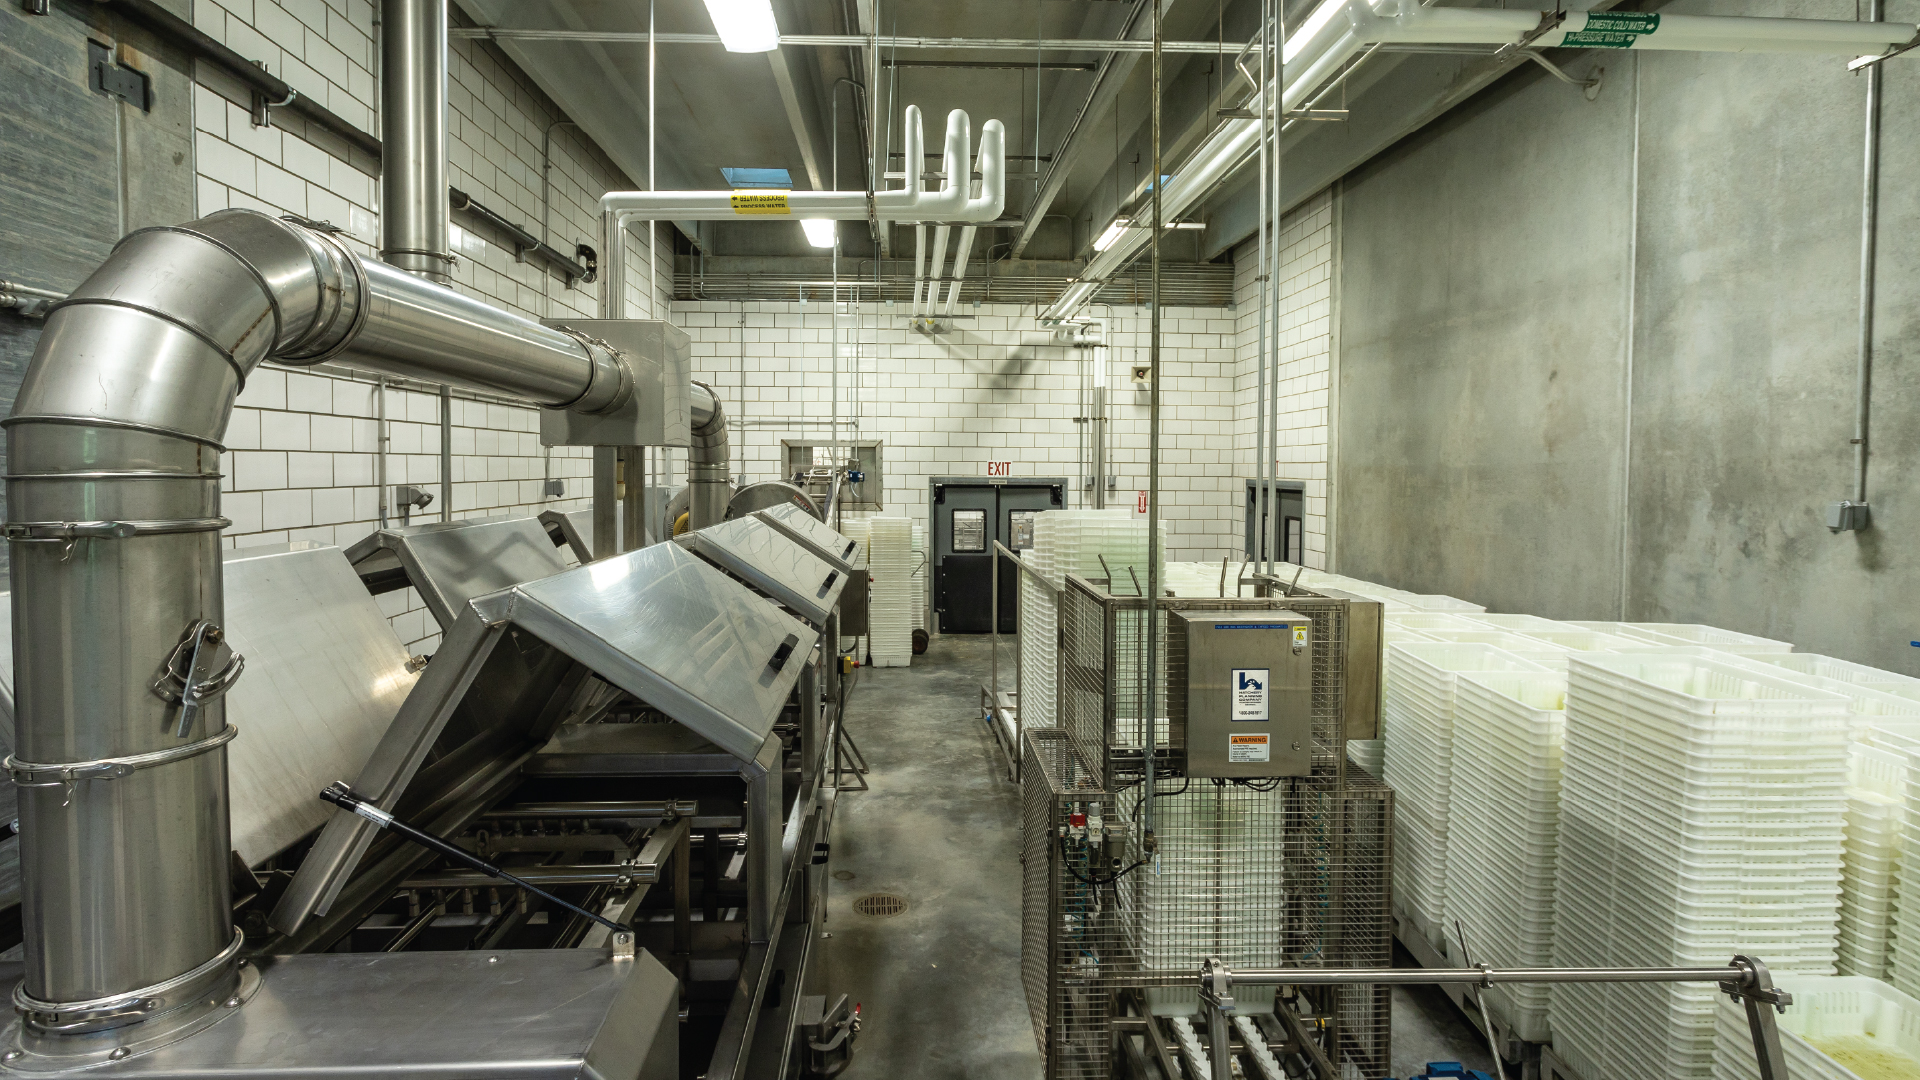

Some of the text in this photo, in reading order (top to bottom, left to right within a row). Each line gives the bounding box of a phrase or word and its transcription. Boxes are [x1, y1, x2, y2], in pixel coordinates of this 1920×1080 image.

[1587, 20, 1646, 30] DOMESTIC COLD WATER
[1604, 34, 1624, 42] WATER
[988, 461, 1012, 476] EXIT
